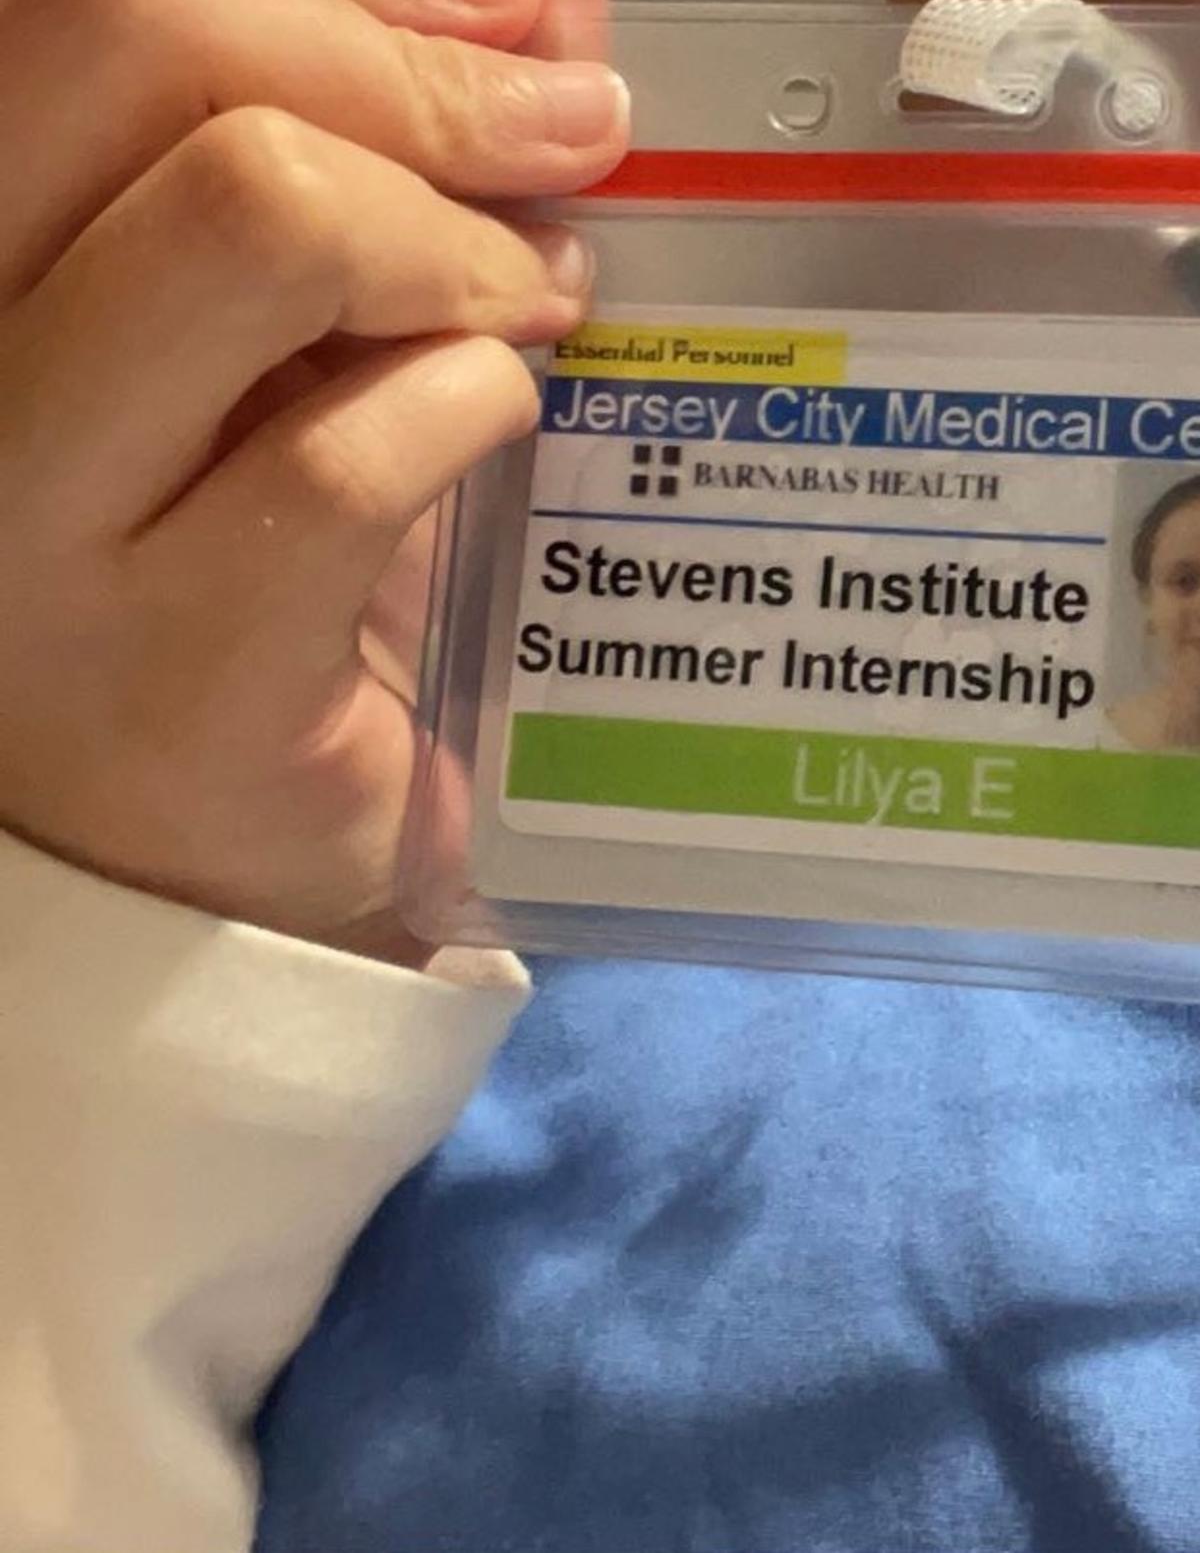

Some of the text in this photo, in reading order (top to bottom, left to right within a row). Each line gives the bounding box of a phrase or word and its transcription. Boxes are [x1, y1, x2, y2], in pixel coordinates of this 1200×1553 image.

[555, 338, 794, 367] Essential Personnel
[553, 380, 738, 446] Jersey
[757, 386, 865, 446] City
[885, 392, 1108, 452] Medical
[693, 460, 998, 501] BARNABAS HEALTH
[541, 541, 1090, 622] Stevens Institute
[517, 623, 1096, 719] Summer Internship
[793, 743, 1017, 826] Lilya E
